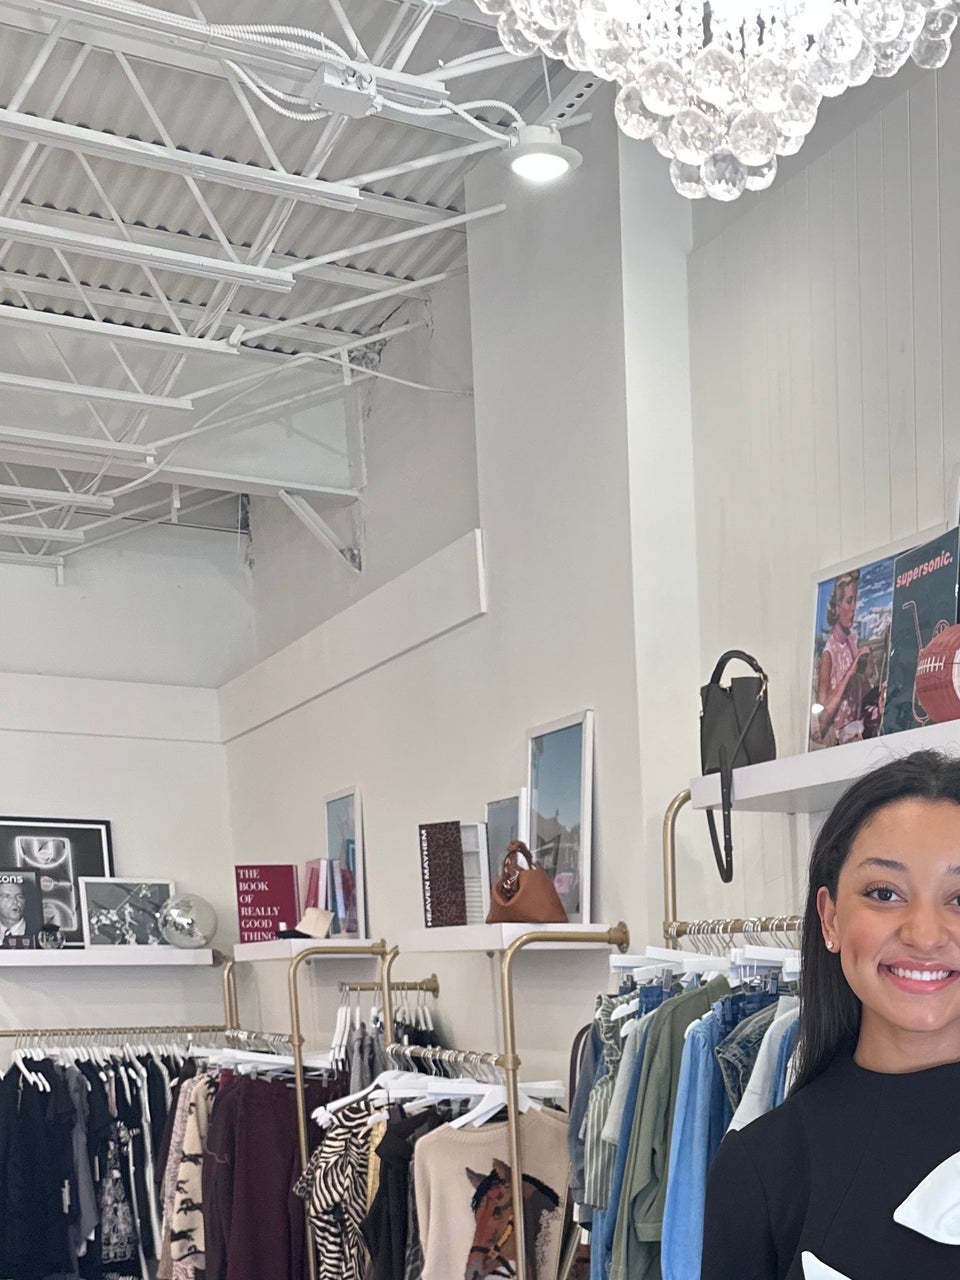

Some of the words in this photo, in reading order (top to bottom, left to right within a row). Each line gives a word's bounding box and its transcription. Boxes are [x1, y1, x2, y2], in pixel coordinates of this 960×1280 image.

[895, 550, 953, 588] supersonic.
[421, 829, 430, 880] MAYHEM
[238, 869, 260, 879] THE
[239, 881, 269, 891] BOOK
[240, 894, 255, 904] OF
[424, 881, 433, 926] HEAVEN
[241, 906, 280, 916] REALLY
[241, 919, 273, 928] GOOD
[242, 931, 279, 941] THING
